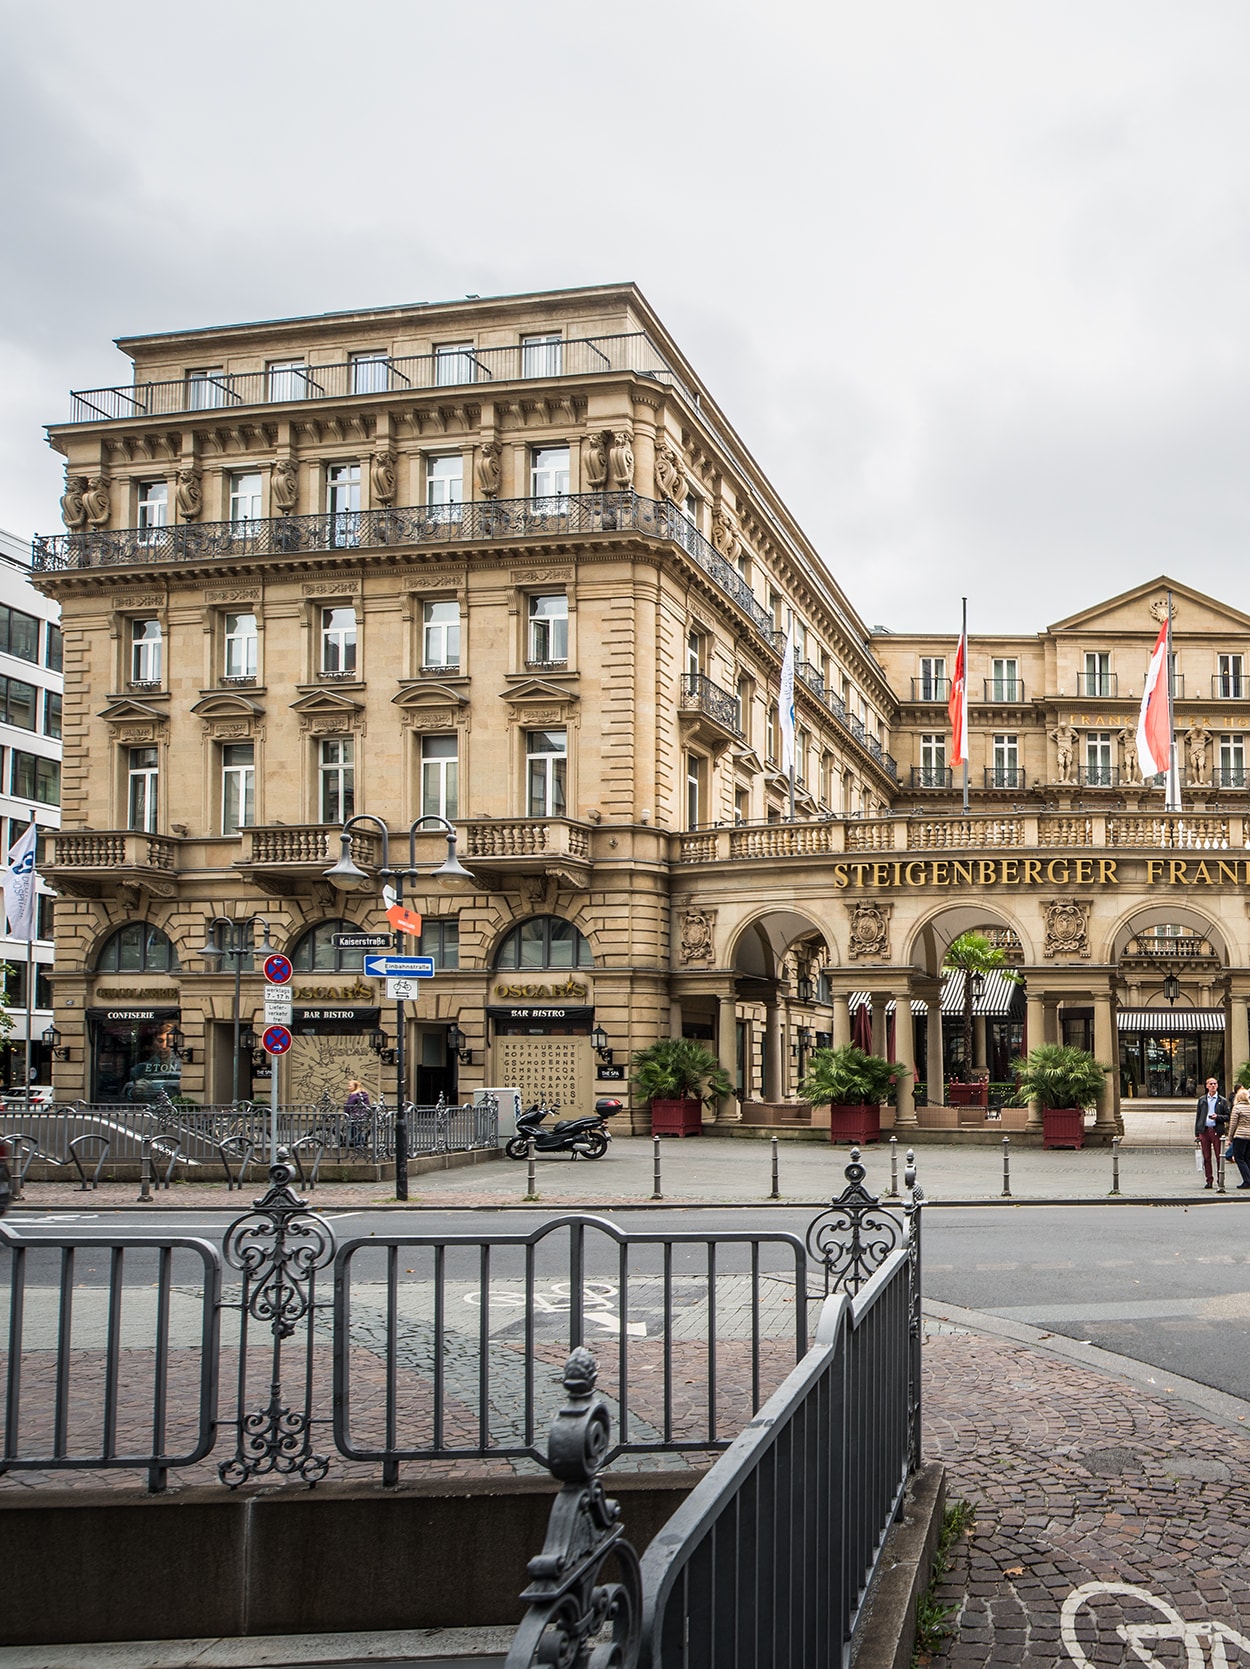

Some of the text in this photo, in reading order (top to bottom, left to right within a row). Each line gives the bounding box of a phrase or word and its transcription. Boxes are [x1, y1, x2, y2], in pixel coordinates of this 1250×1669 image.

[1070, 714, 1212, 727] FRANKTER
[834, 859, 1119, 888] STEIGENBERGER
[339, 937, 386, 946] Kaiserstraße
[384, 962, 430, 970] Einbahnstraße
[107, 1011, 155, 1019] CONFISERIE
[303, 1011, 354, 1019] BAR BISTRO
[532, 1009, 565, 1017] BISTRO
[145, 1063, 178, 1072] ETON
